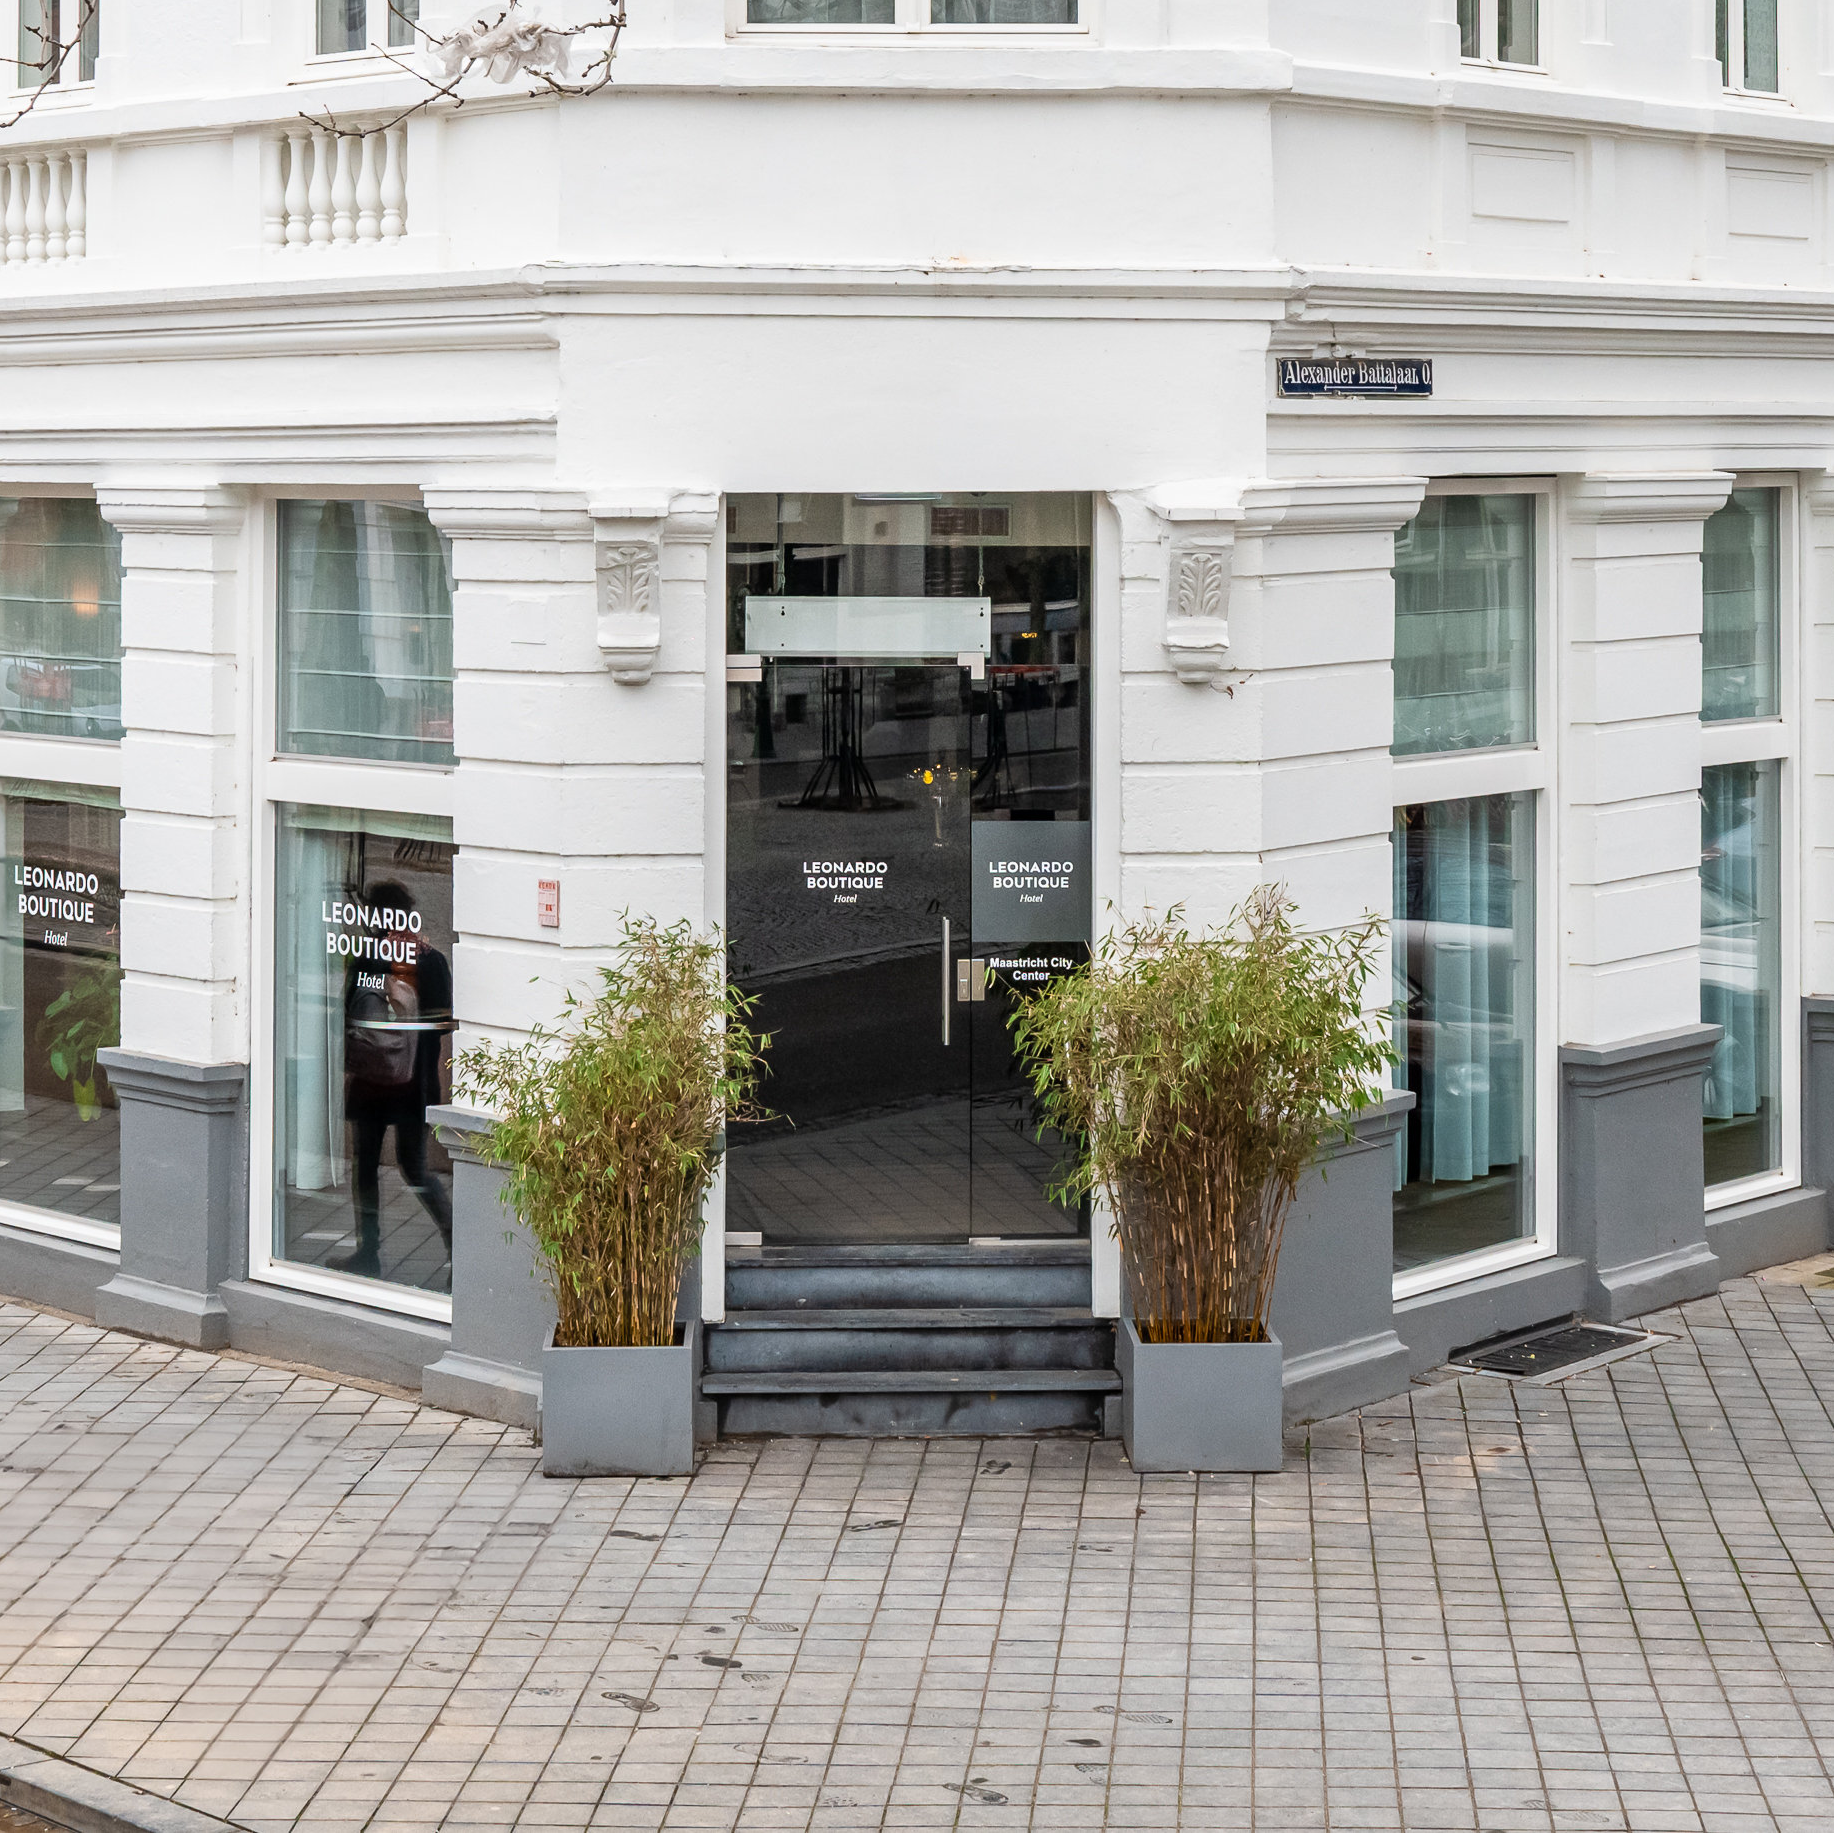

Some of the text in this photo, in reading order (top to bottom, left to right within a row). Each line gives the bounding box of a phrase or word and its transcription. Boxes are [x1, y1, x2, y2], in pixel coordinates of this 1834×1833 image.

[1284, 360, 1356, 384] Alexander
[803, 861, 888, 874] LEONARDO
[989, 861, 1074, 873] LEONARDO
[14, 865, 99, 895] LEONARDO
[807, 876, 884, 889] BOUTIQUE
[993, 876, 1069, 888] BOUTIQUE
[833, 894, 858, 903] Hotel
[1019, 893, 1044, 903] Hotel
[18, 893, 94, 924] BOUTIQUE
[322, 900, 422, 934] LEONARDO
[44, 929, 68, 947] Hotel
[327, 932, 417, 965] BOUTIQUE
[989, 957, 1073, 970] Maastricht City
[356, 971, 386, 990] Hotel
[1012, 970, 1051, 981] Center
